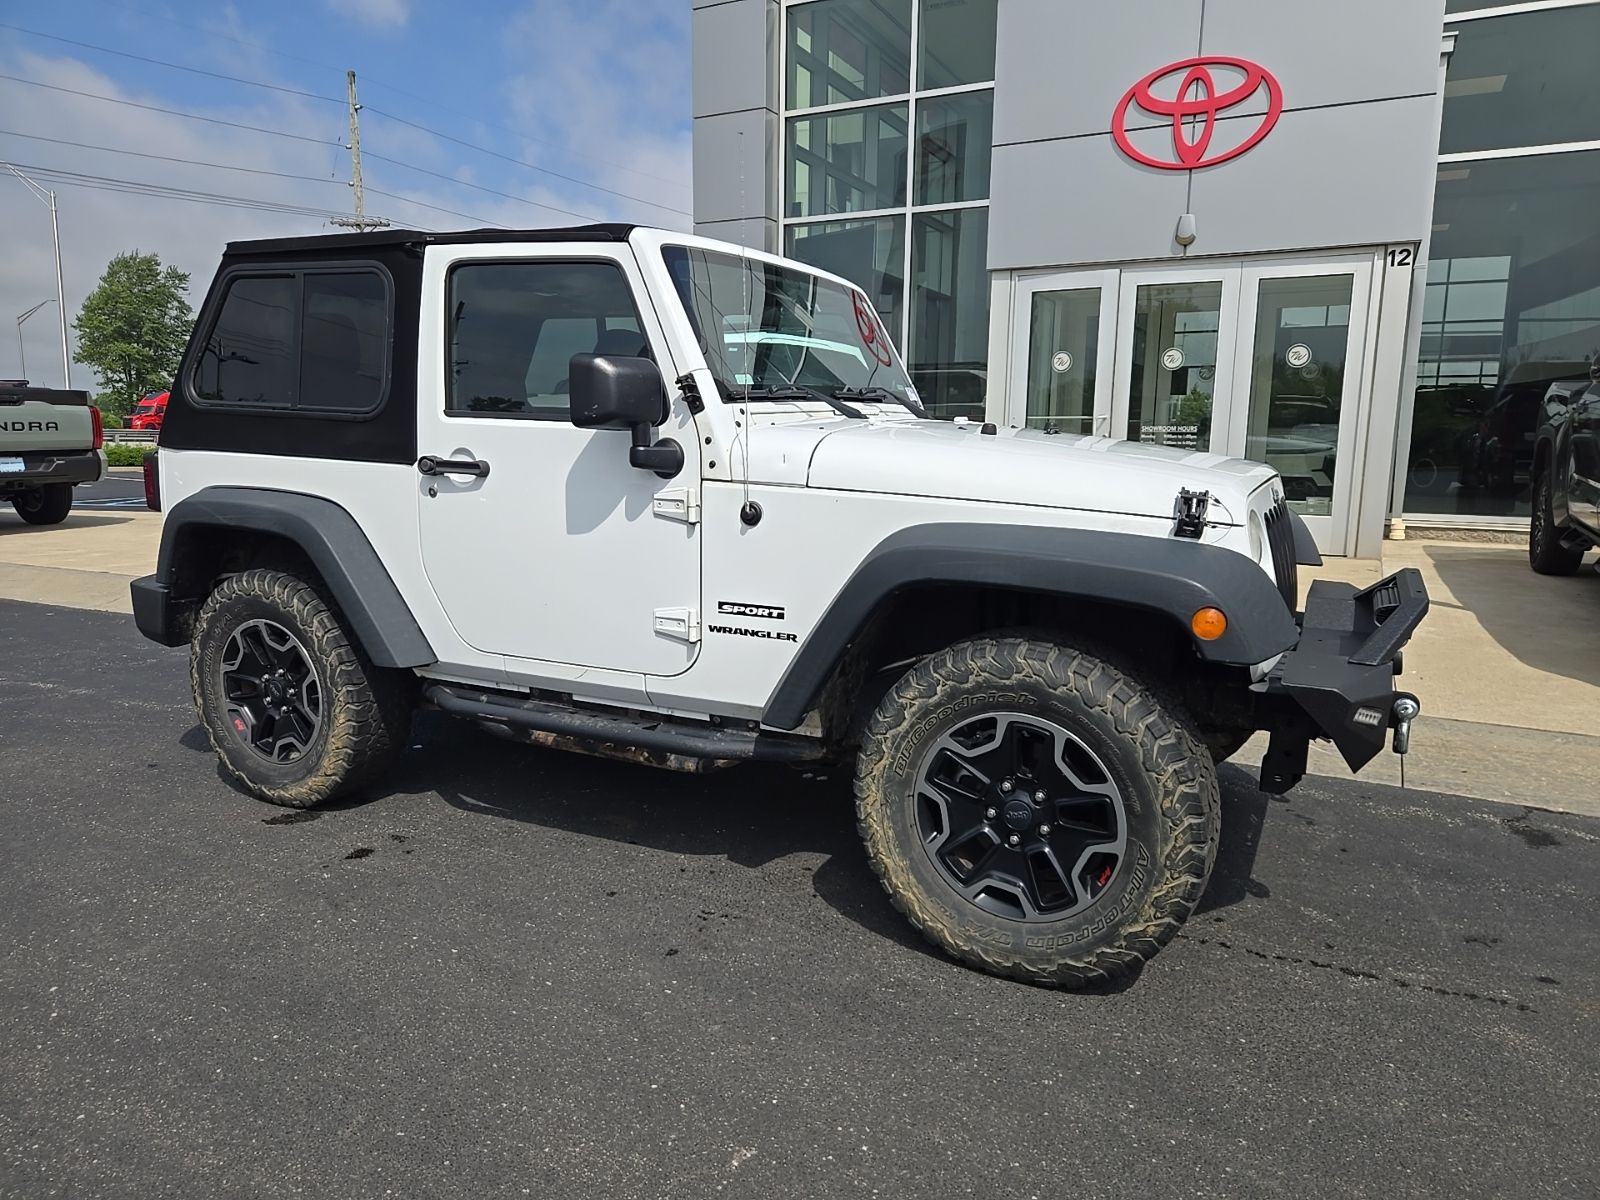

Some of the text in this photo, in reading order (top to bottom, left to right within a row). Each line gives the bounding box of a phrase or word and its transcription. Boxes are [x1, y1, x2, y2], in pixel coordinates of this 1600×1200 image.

[1388, 248, 1412, 267] 12
[718, 602, 785, 619] SPORT
[708, 624, 798, 642] WRANGLER
